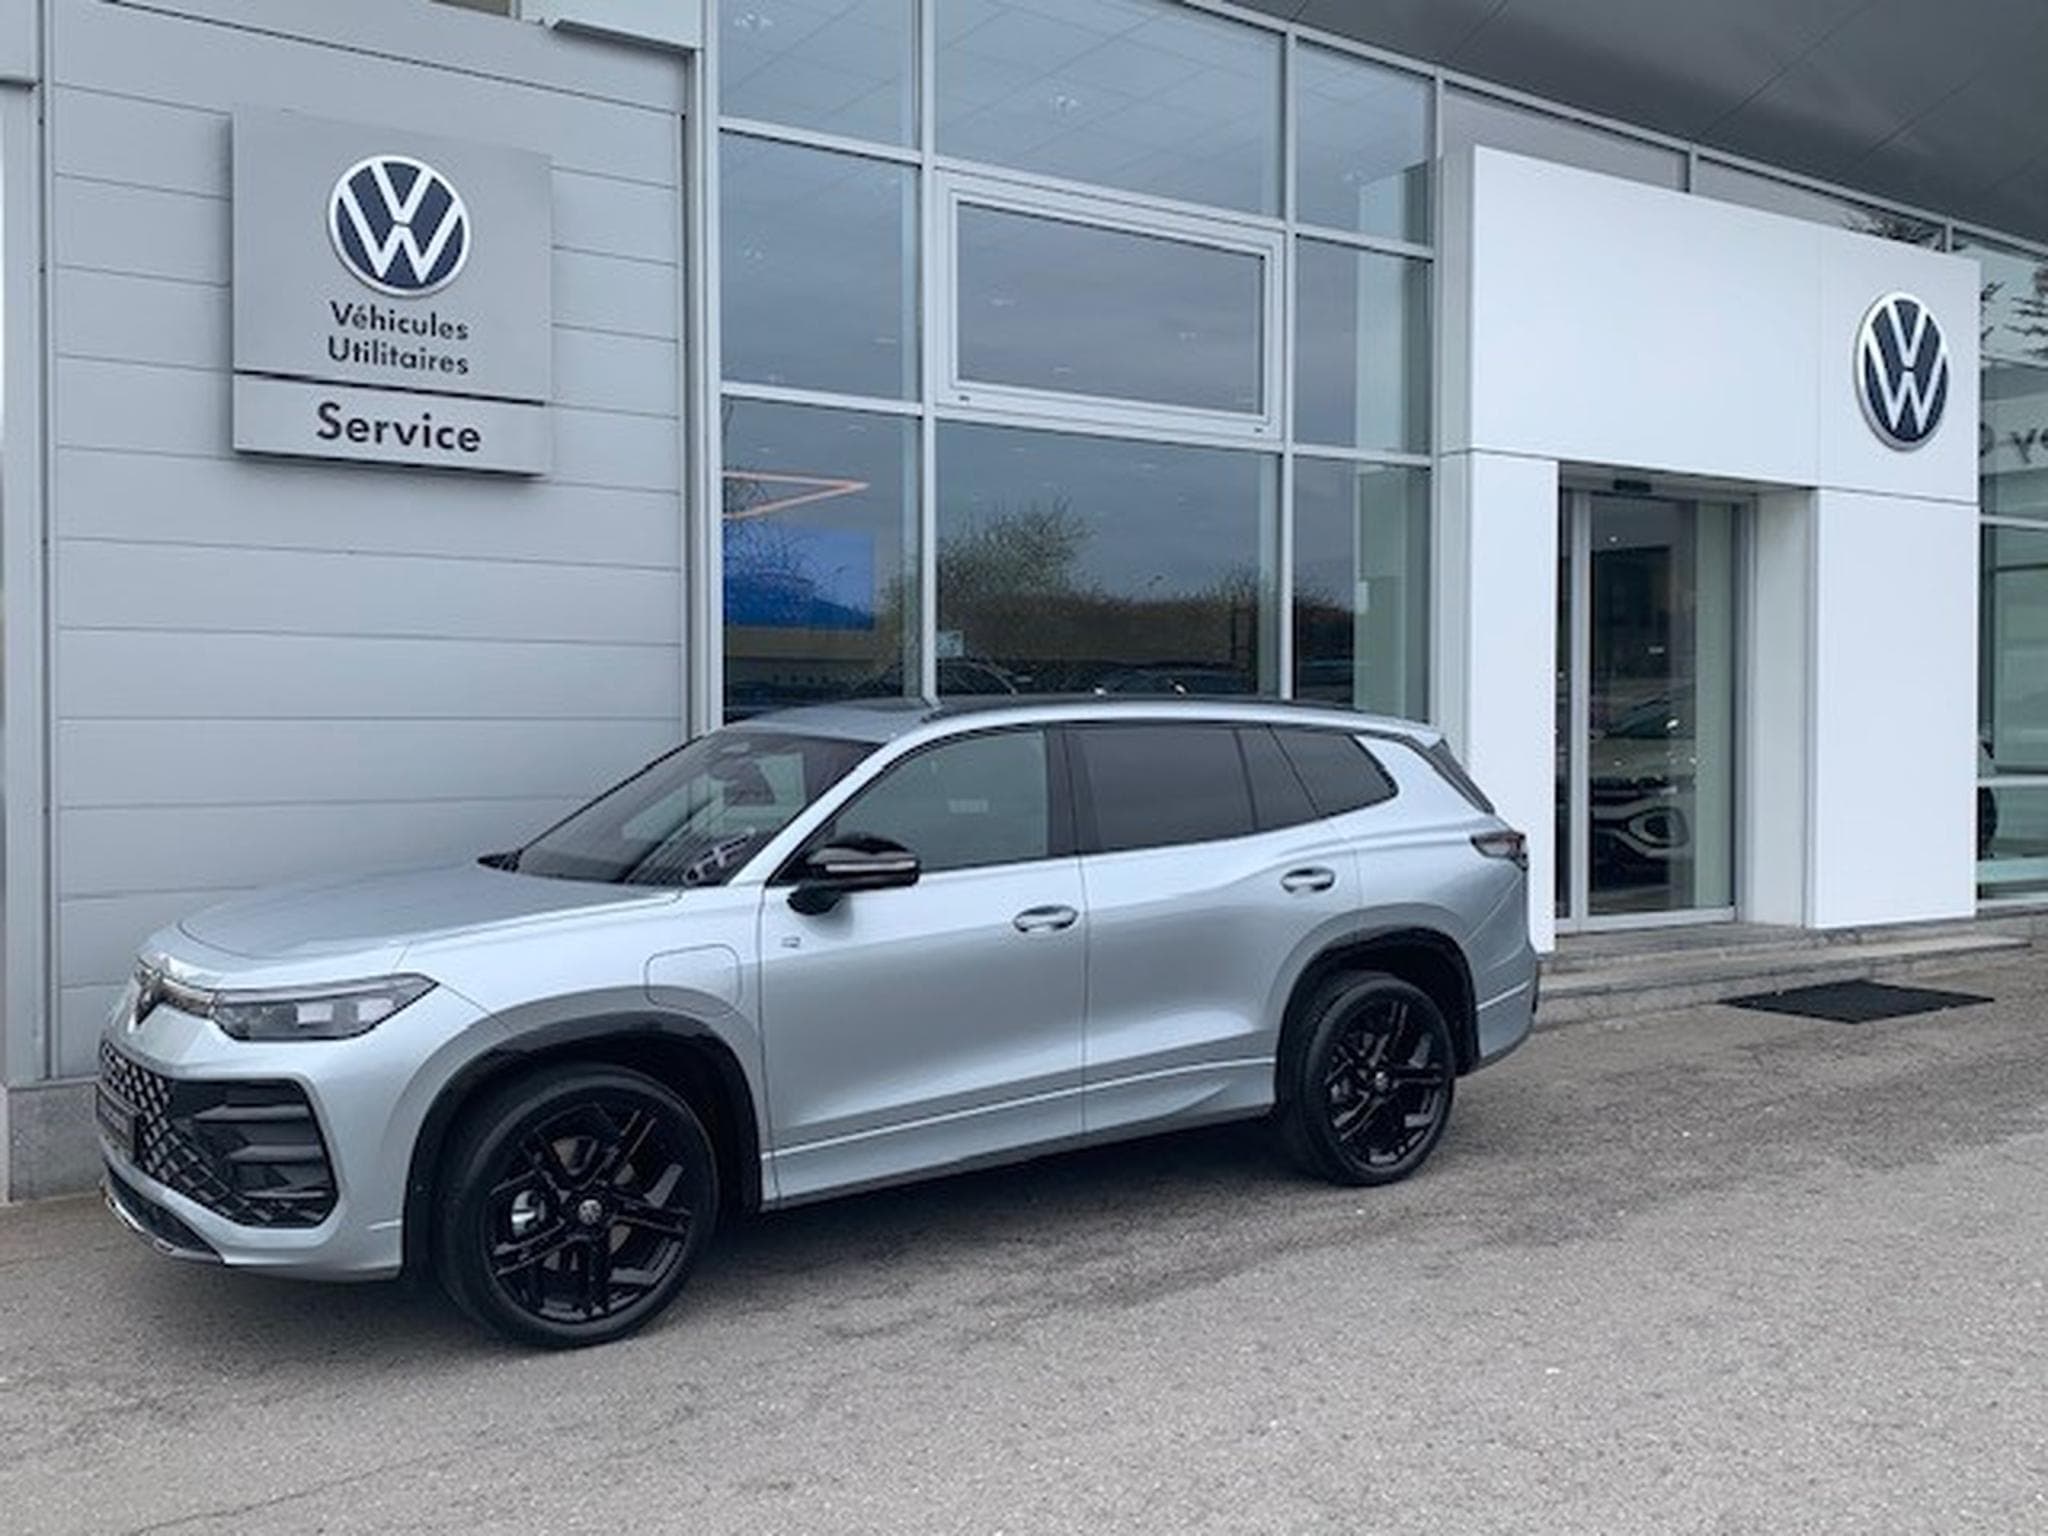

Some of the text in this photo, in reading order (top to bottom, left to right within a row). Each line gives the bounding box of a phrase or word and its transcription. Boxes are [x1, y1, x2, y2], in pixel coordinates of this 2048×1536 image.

[332, 157, 468, 291] VW
[329, 300, 469, 340] Véhicules
[327, 334, 469, 375] Utilitaires
[1860, 294, 1949, 446] VW
[315, 400, 482, 453] Service
